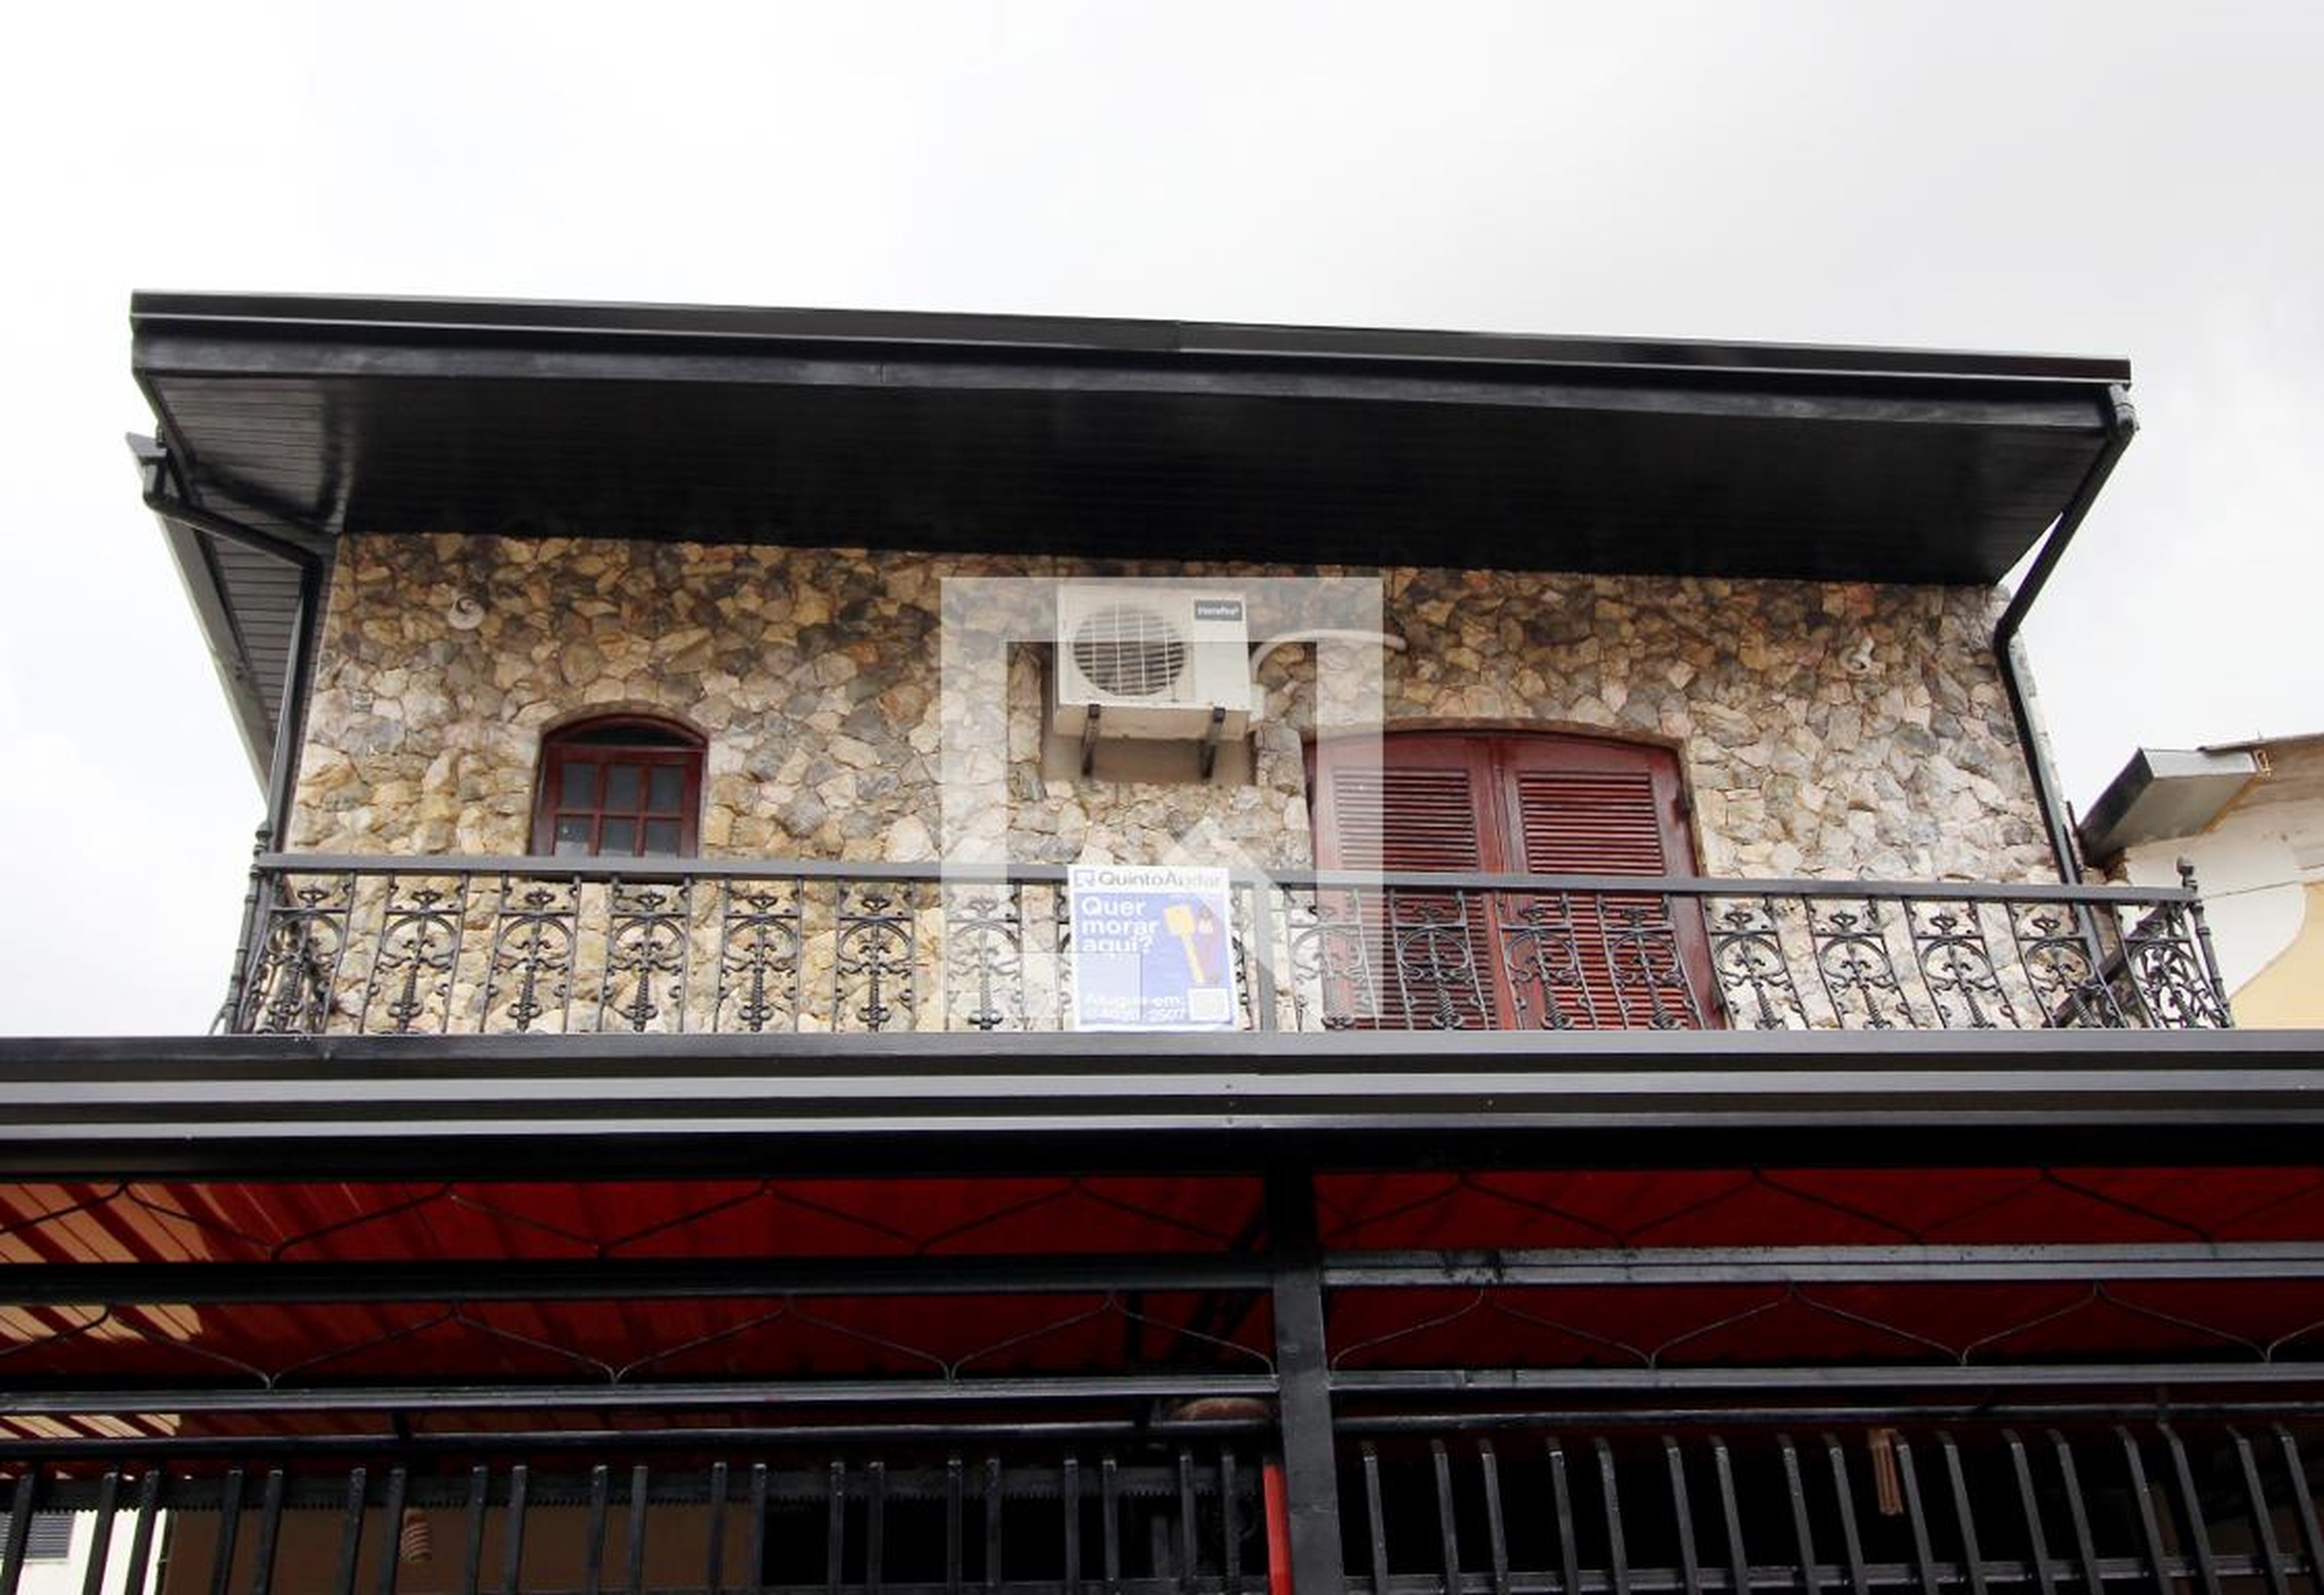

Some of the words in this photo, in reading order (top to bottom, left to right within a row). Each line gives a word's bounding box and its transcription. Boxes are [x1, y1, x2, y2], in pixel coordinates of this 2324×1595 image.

[1098, 870, 1221, 887] QuintoAndar
[1082, 896, 1147, 916] Quer
[1082, 919, 1161, 935] morar
[1082, 935, 1152, 955] aqui?
